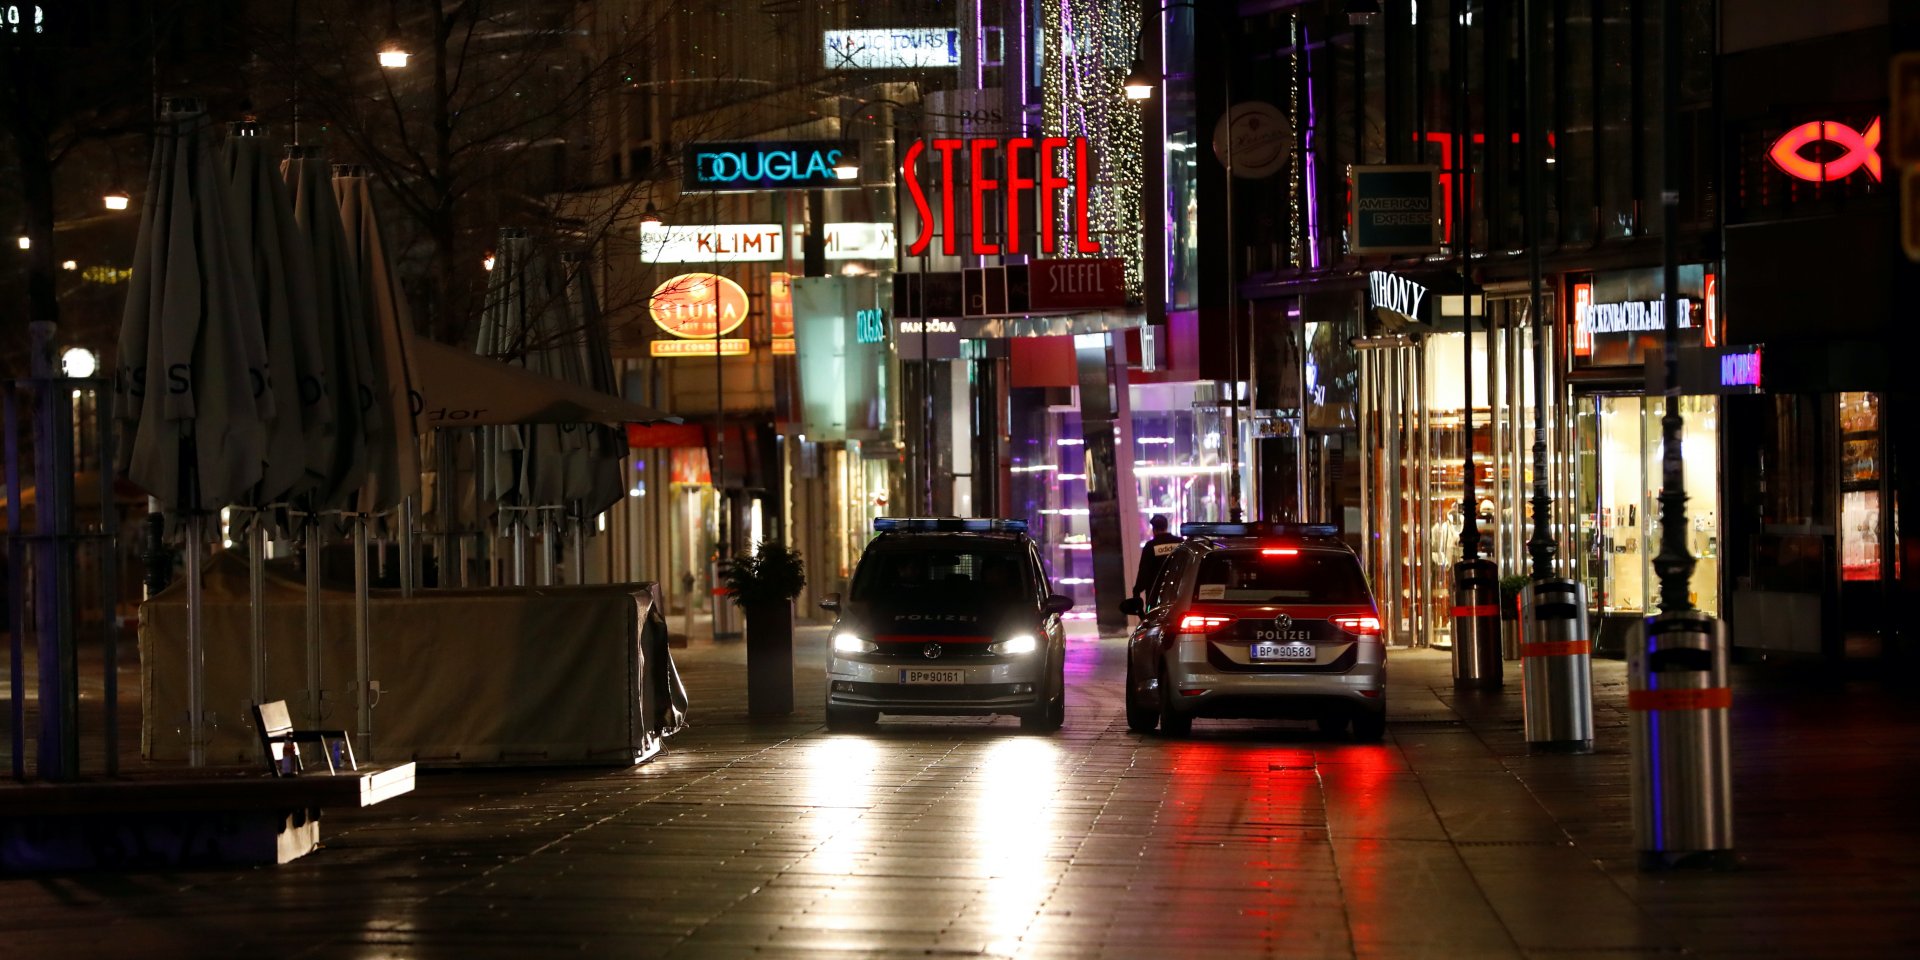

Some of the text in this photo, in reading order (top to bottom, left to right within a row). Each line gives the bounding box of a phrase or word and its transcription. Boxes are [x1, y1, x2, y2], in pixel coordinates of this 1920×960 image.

[828, 33, 944, 50] MAGIC TOURS
[697, 150, 843, 181] DOUGLAS
[903, 137, 1100, 256] STEFFL
[1359, 199, 1428, 210] AMERICAN
[1375, 213, 1432, 225] EXPRESS
[697, 232, 780, 253] KLIMT
[1050, 264, 1104, 293] STEFFL
[661, 303, 737, 320] SLUKA
[894, 614, 978, 622] POLIZEI
[1256, 630, 1311, 640] POLIZEI
[1260, 646, 1311, 657] BP 90583
[910, 671, 958, 682] BP 90161
